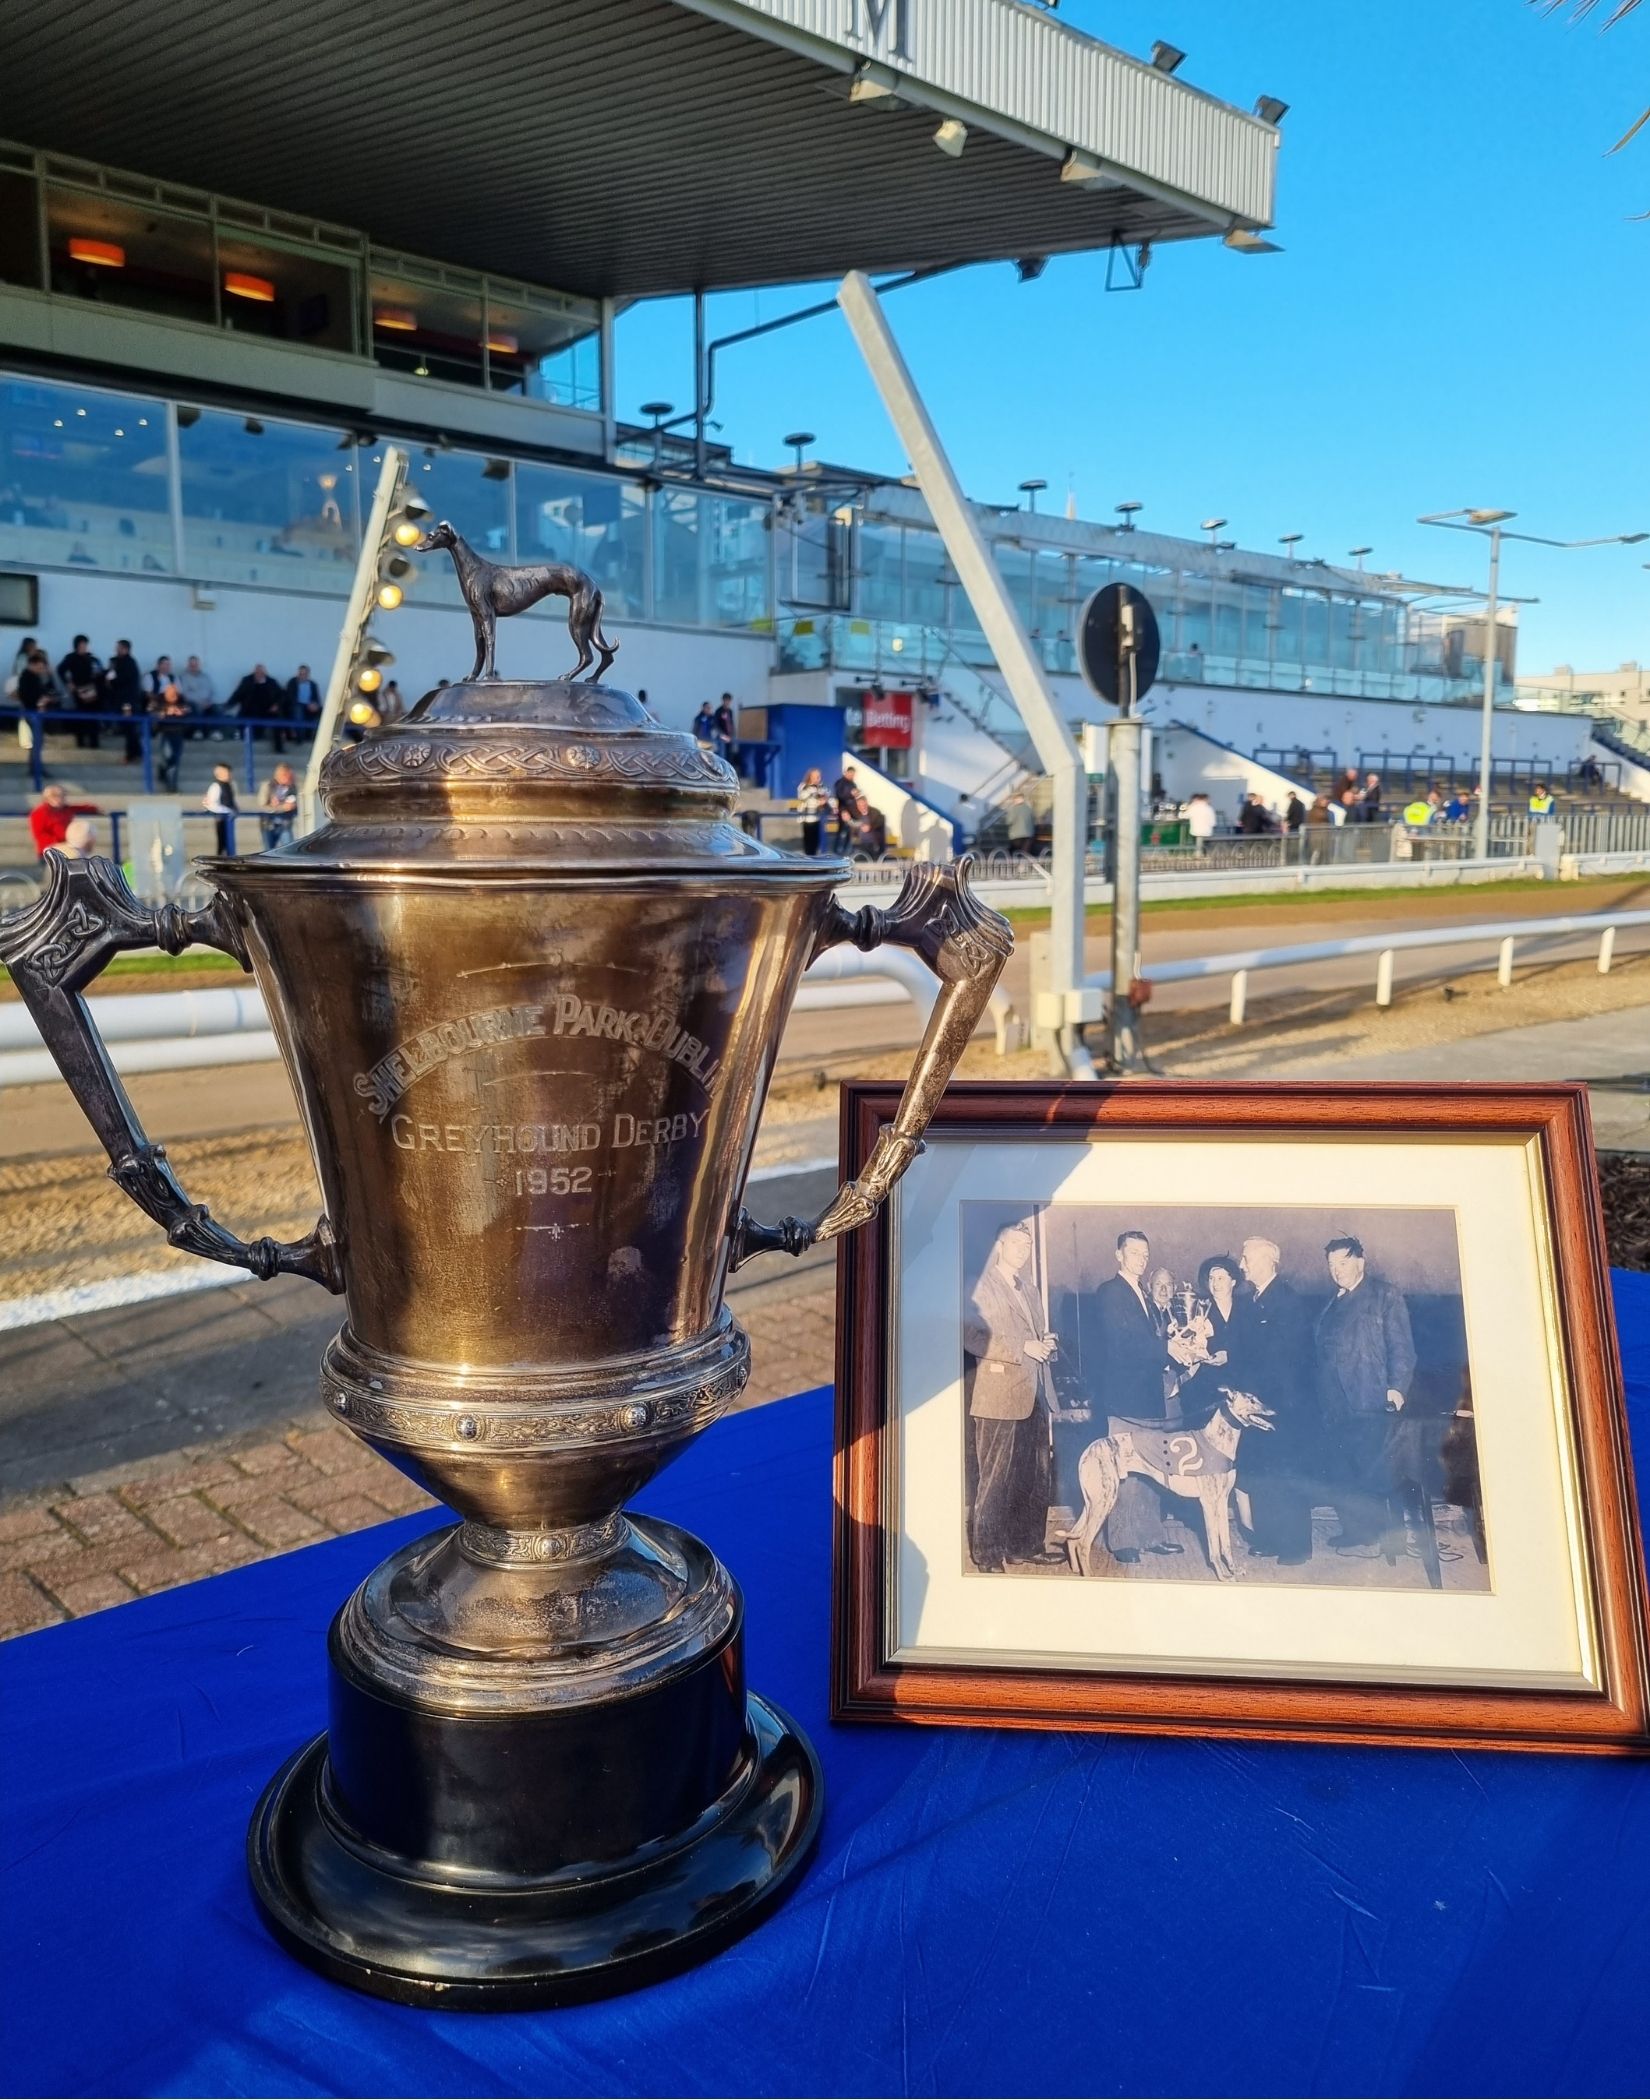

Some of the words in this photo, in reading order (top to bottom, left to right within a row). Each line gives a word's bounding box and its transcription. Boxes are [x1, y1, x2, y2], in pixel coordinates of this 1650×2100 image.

[866, 710, 910, 734] Betting
[353, 1005, 545, 1117] SHELBOURNE
[391, 1113, 601, 1154] GREYHOUND
[611, 1108, 710, 1149] DERBY
[514, 1166, 592, 1196] 1952
[1169, 1436, 1203, 1476] 2
